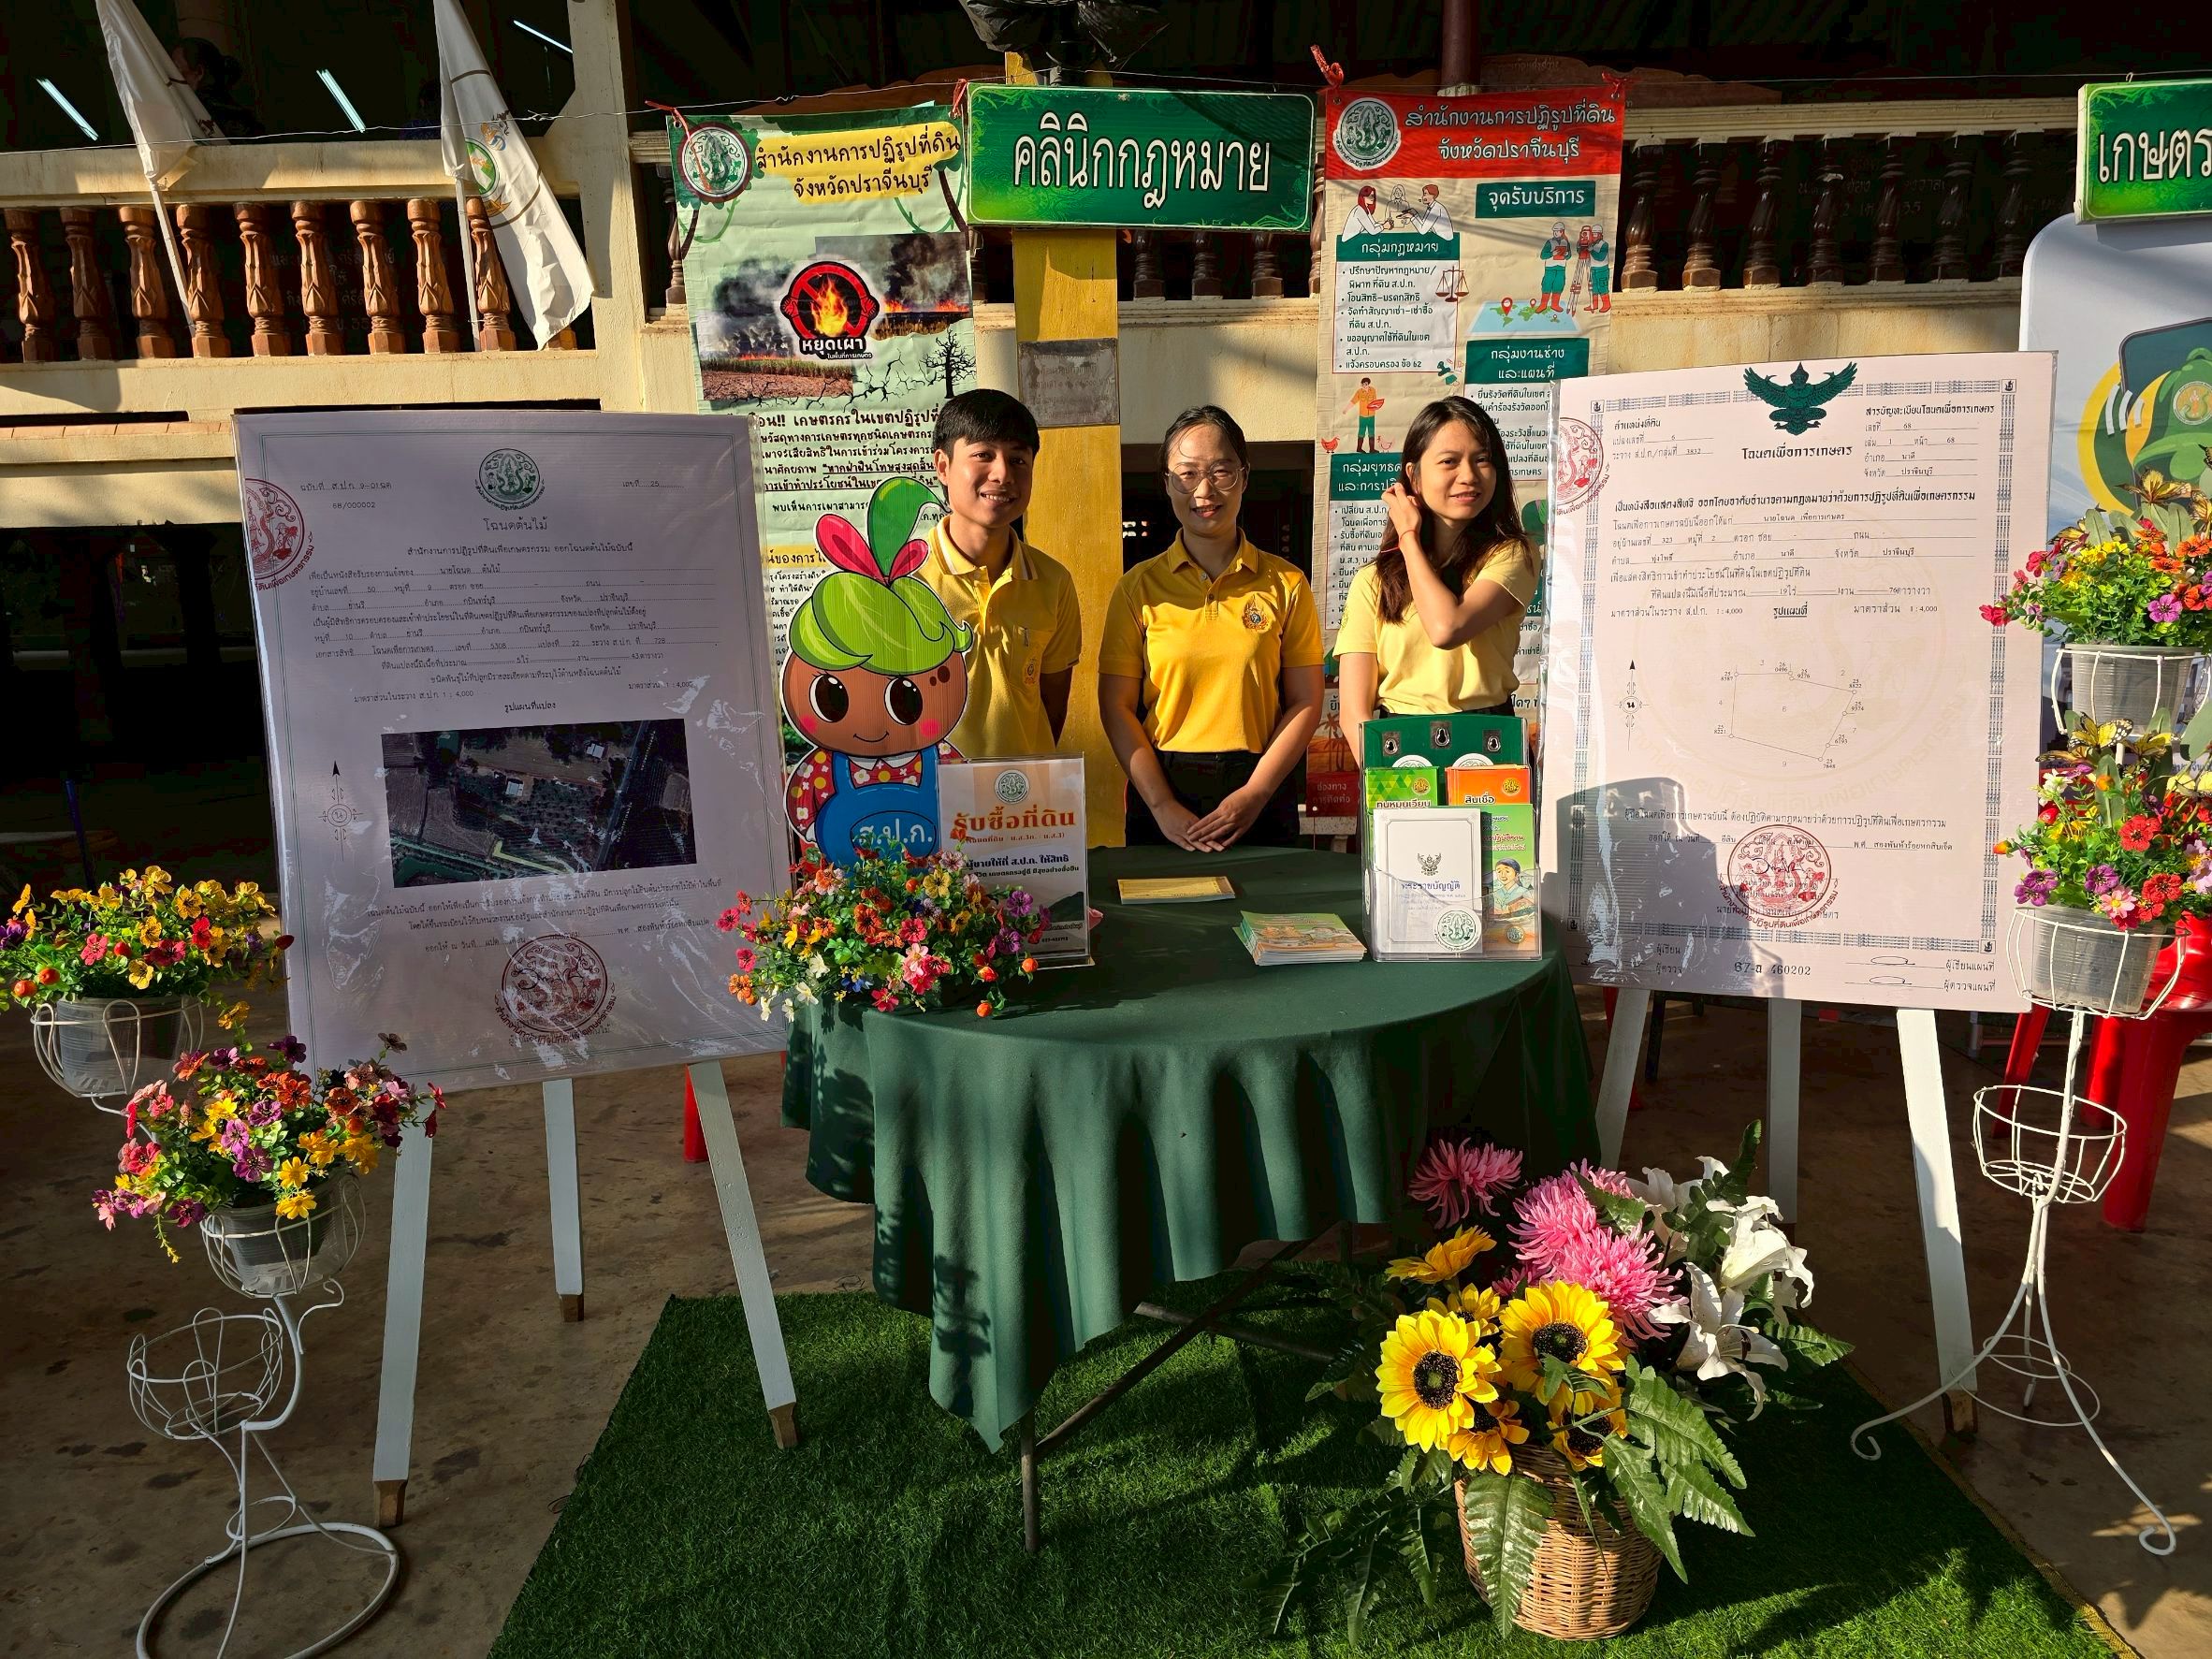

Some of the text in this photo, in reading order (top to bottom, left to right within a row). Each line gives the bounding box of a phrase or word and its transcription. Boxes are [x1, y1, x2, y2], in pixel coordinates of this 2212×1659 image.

[1404, 98, 1615, 131] สำนักงานการปฏิรูปที่ดิน
[757, 125, 960, 169] สำนักงานการปฏิรูปที่ดิน
[1438, 136, 1579, 165] จังหวัดปราจีนบุรี
[1014, 111, 1270, 209] คลินิกกฎหมาย
[794, 167, 932, 197] จังหวัดปราจีนบุรี
[1489, 186, 1584, 211] จุดรับบริการ
[1362, 239, 1438, 257] กลุ่มกฎหมาย
[1374, 278, 1390, 288] ที่ดิน
[1392, 279, 1415, 288] ส.ป.ก.
[1349, 319, 1391, 328] ที่ดิน ส.ป.ก.
[802, 338, 864, 355] หยุดเผา
[1346, 346, 1370, 355] ส.ป.ก.
[1492, 345, 1564, 363] กลุ่มงานช่าง
[1499, 362, 1554, 379] และแผนที่
[1866, 400, 1995, 417] สารบัญทะเบียนโฉนดเพื่อการเกษตร
[1614, 415, 1661, 430] ตำแหน่งที่ดิน
[1741, 442, 1853, 459] โฉนดเพื่อการเกษตร
[1342, 502, 1364, 515] เปลี่ยน
[1615, 497, 1694, 512] เป็นหนังสือแสดงสิทธิ
[483, 517, 547, 531] โฉนดต้นไม้
[407, 542, 550, 557] สำนักงานการปฏิรูปที่ดินเพื่อเกษตรกรรม
[1773, 602, 1808, 617] รูปแผนที่
[1465, 792, 1496, 804] สินเชื่อ
[953, 804, 1075, 831] รับซื้อที่ดิน
[1770, 964, 1811, 976] 460202
